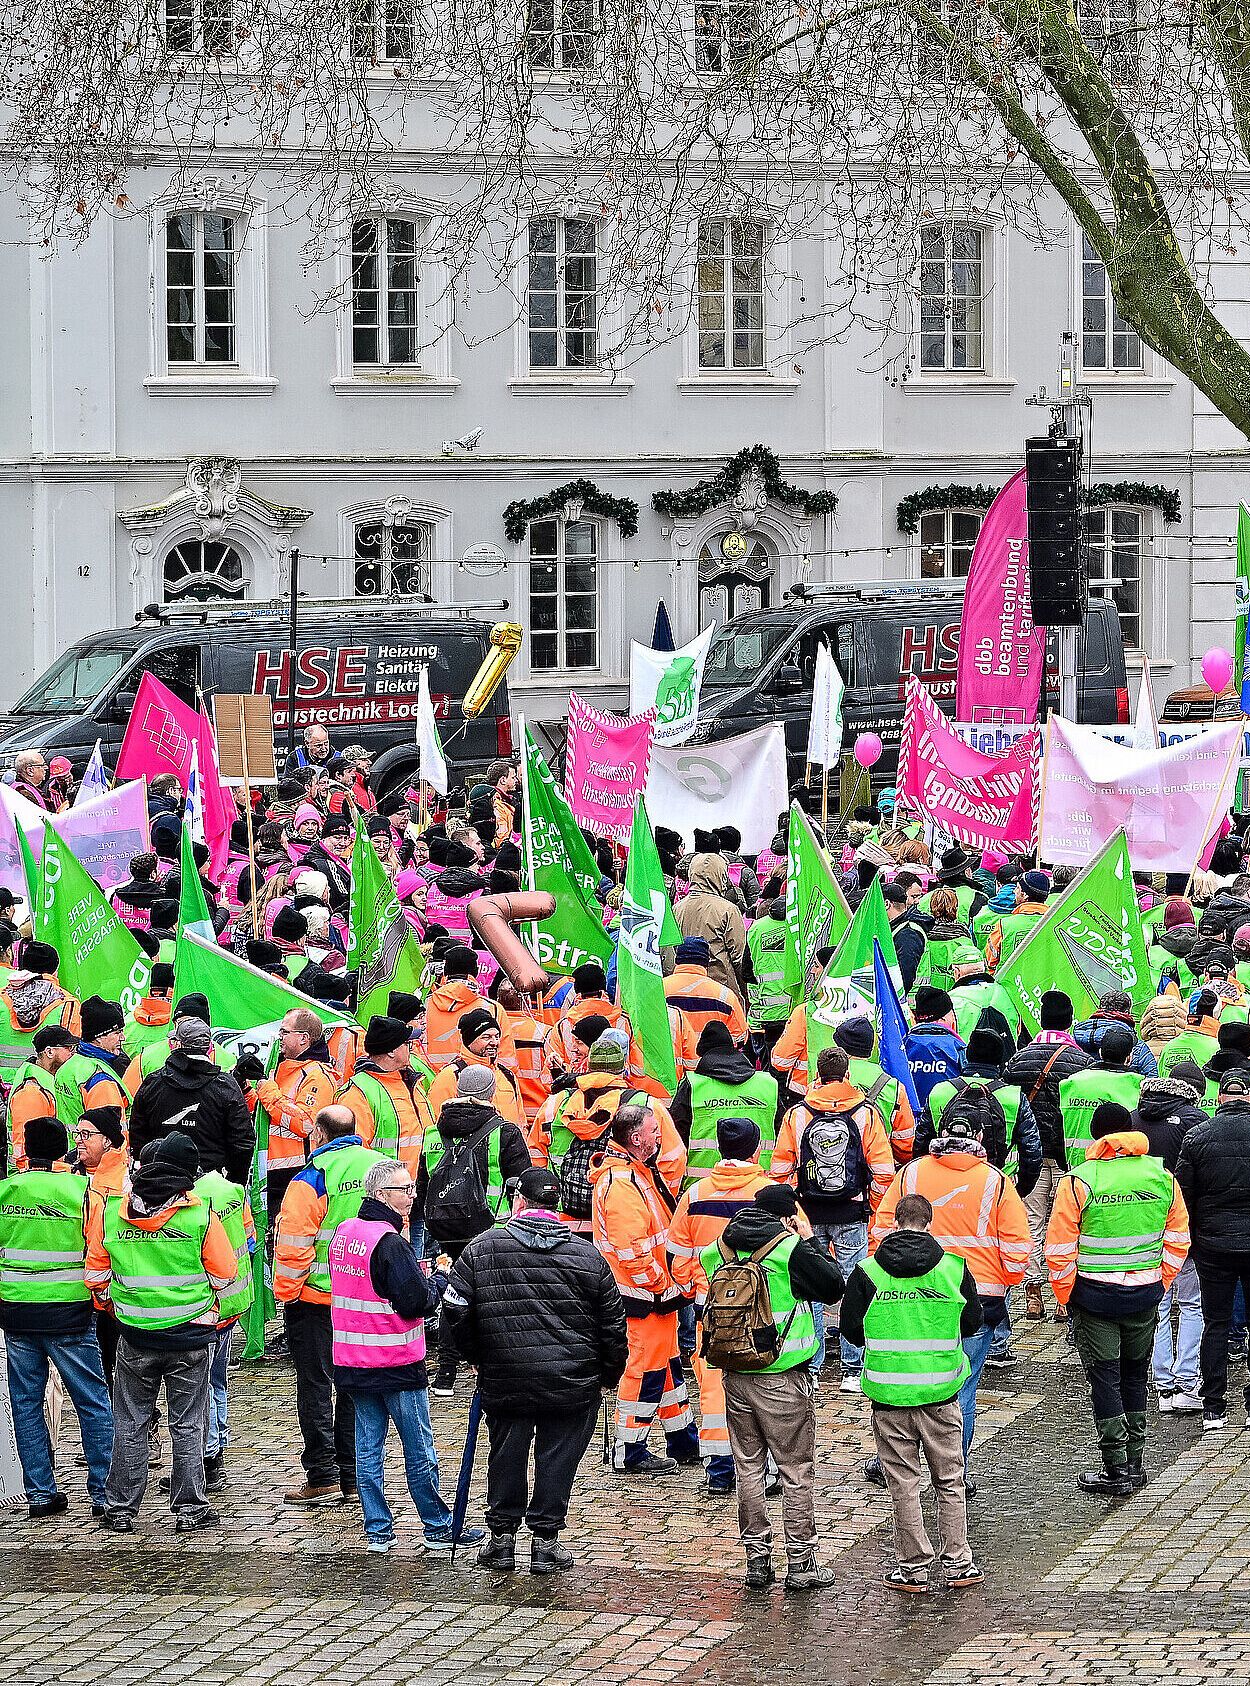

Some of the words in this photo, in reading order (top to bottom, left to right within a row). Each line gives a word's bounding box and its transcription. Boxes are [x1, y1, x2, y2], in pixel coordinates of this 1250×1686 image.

[77, 565, 90, 577] 12
[993, 538, 1023, 676] beamtenbund
[377, 645, 438, 659] Heizung
[899, 624, 960, 674] HS
[975, 636, 994, 676] dbb
[375, 660, 429, 675] Sanitär
[1015, 644, 1031, 677] und
[251, 645, 369, 699] HSE
[375, 679, 421, 693] Elektr
[273, 700, 382, 726] austechnik
[1014, 974, 1042, 1026] STRAS
[338, 1179, 363, 1193] VDSt
[117, 1227, 162, 1240] VDStra.
[347, 1239, 367, 1257] dbb
[875, 1288, 919, 1302] VDStra.
